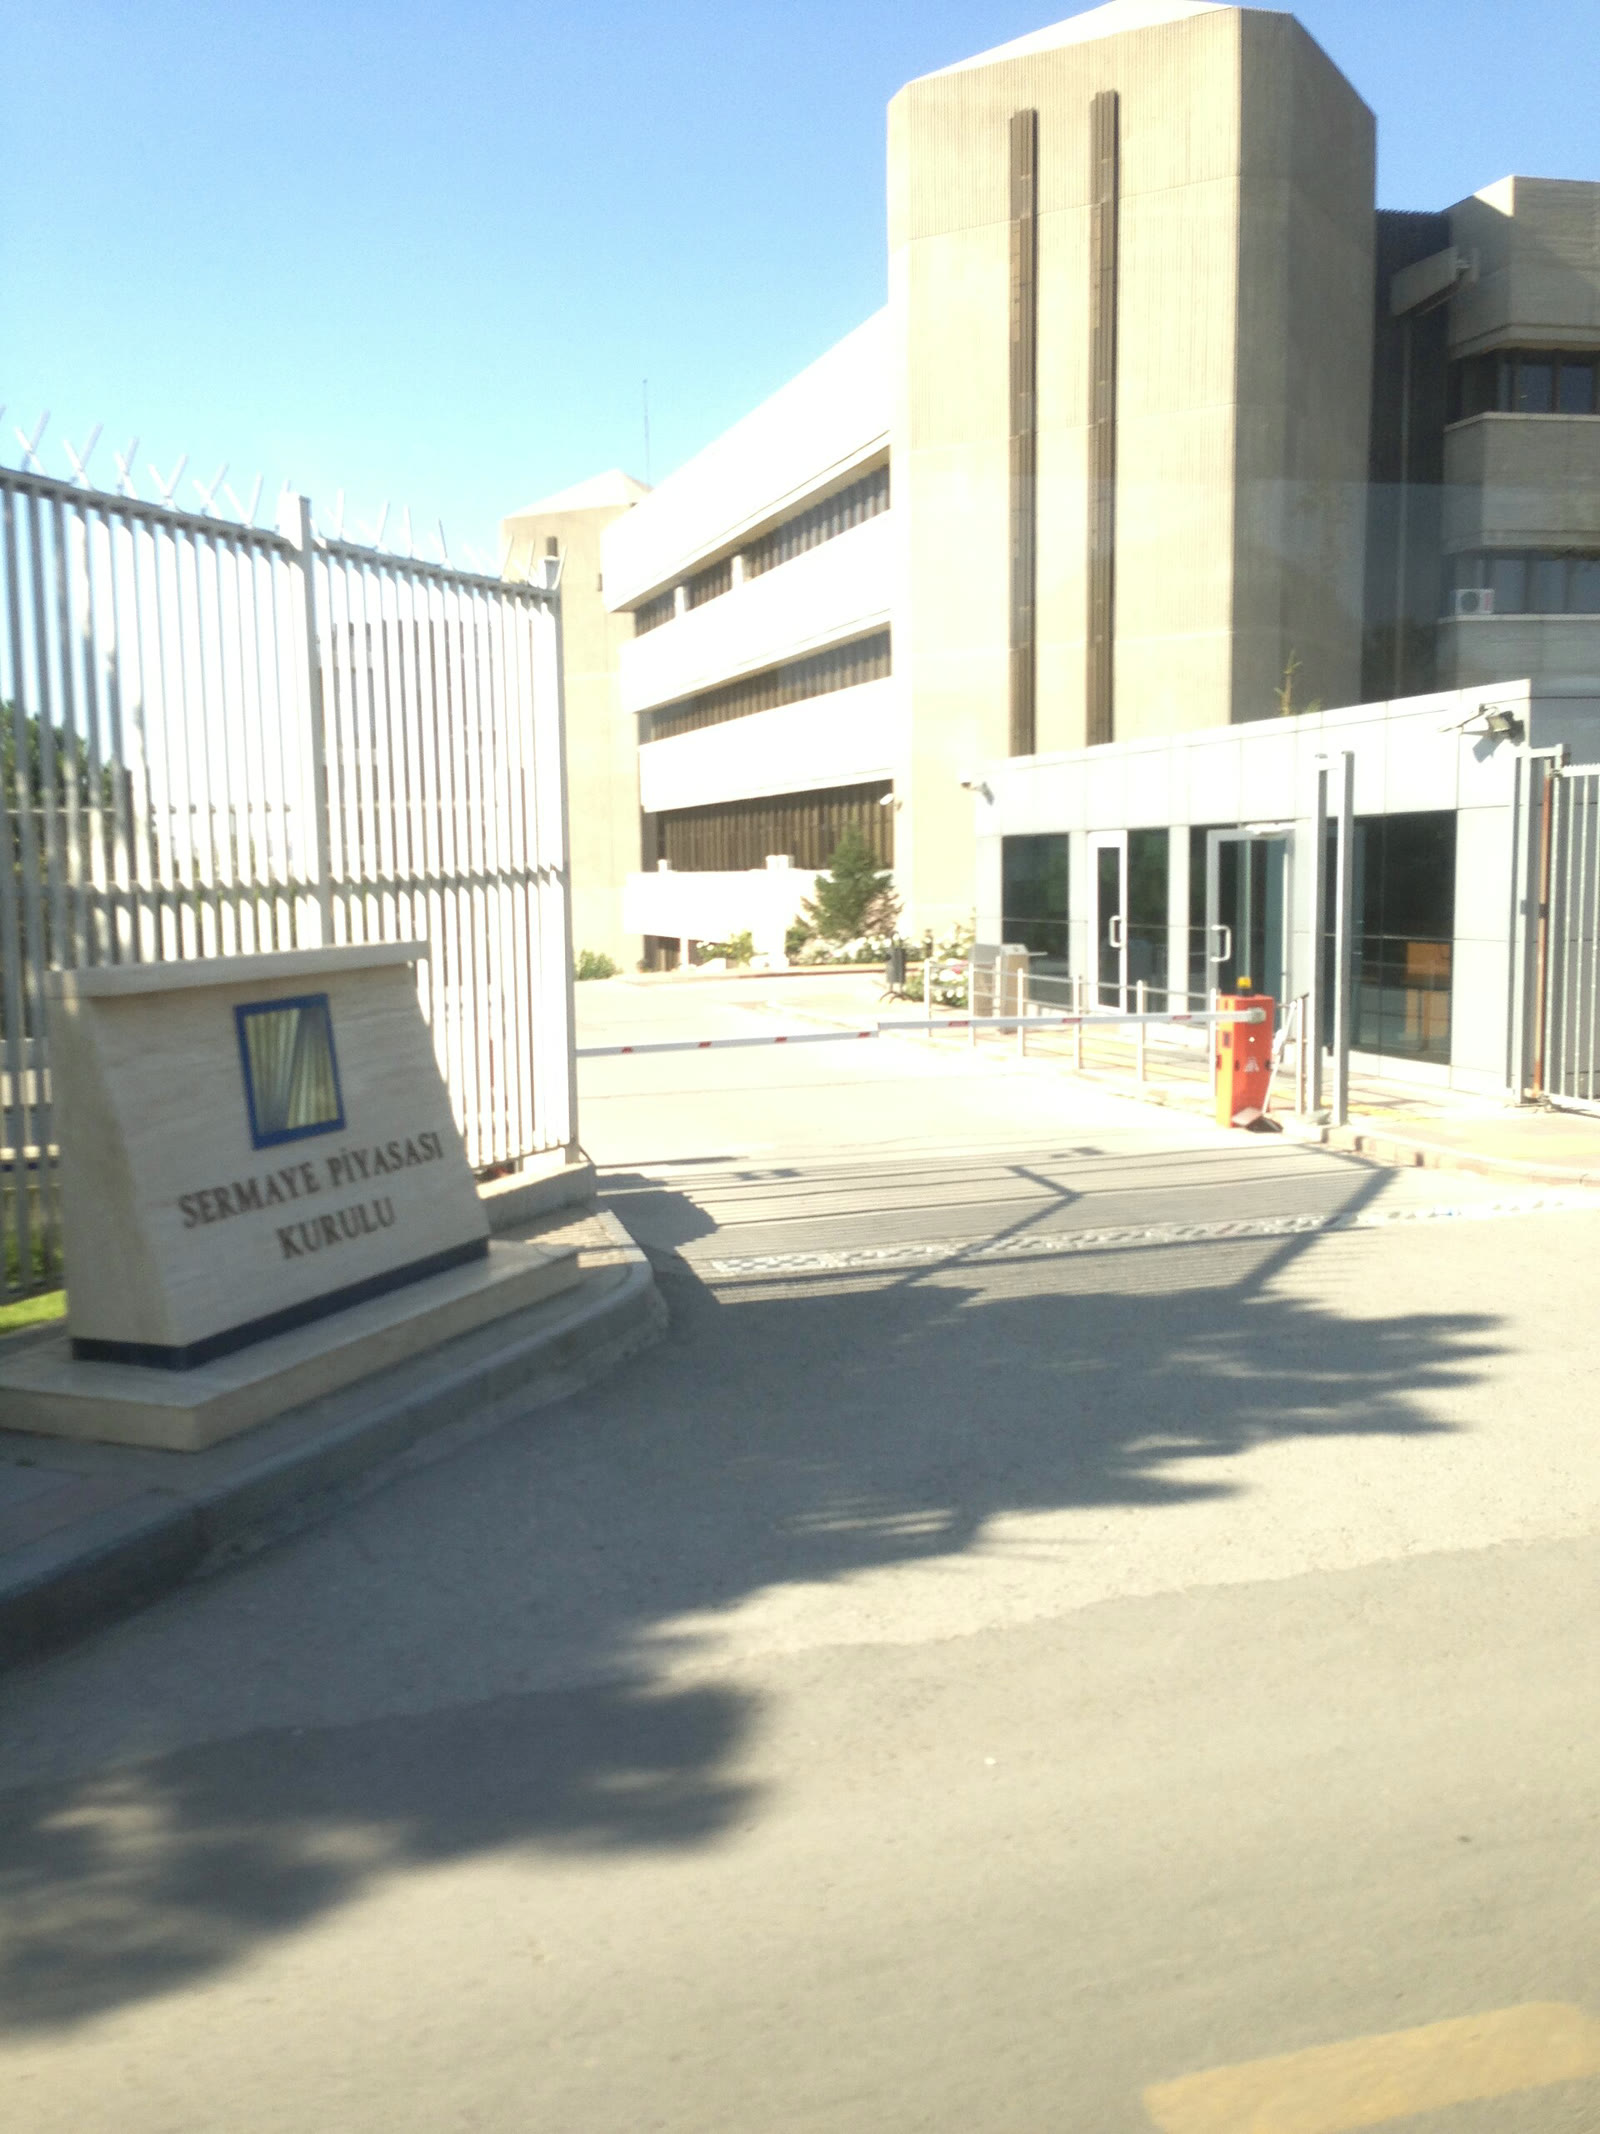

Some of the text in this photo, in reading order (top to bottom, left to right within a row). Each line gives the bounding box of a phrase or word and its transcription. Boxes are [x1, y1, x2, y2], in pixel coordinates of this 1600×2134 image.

[178, 1131, 444, 1229] SERMAYE PİYASASI
[276, 1197, 397, 1259] KURULU
